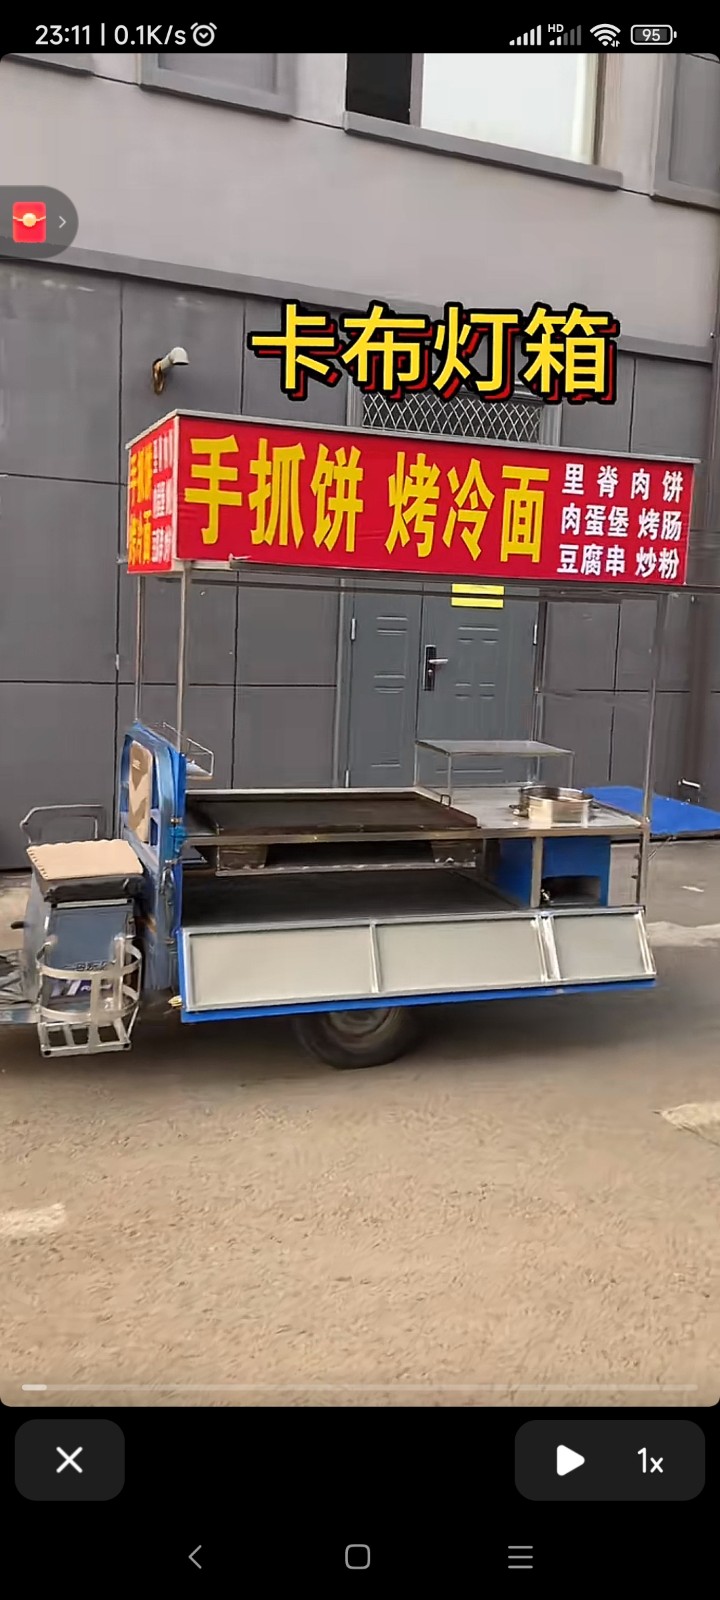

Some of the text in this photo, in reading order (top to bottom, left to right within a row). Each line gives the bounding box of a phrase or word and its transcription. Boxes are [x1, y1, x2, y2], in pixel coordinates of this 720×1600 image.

[184, 435, 364, 553] 手抓饼
[385, 451, 550, 562] 烤冷面
[562, 463, 684, 503] 里脊肉饼
[561, 502, 682, 541] 肉蛋堡 烤肠
[557, 543, 680, 579] 豆腐串 炒粉
